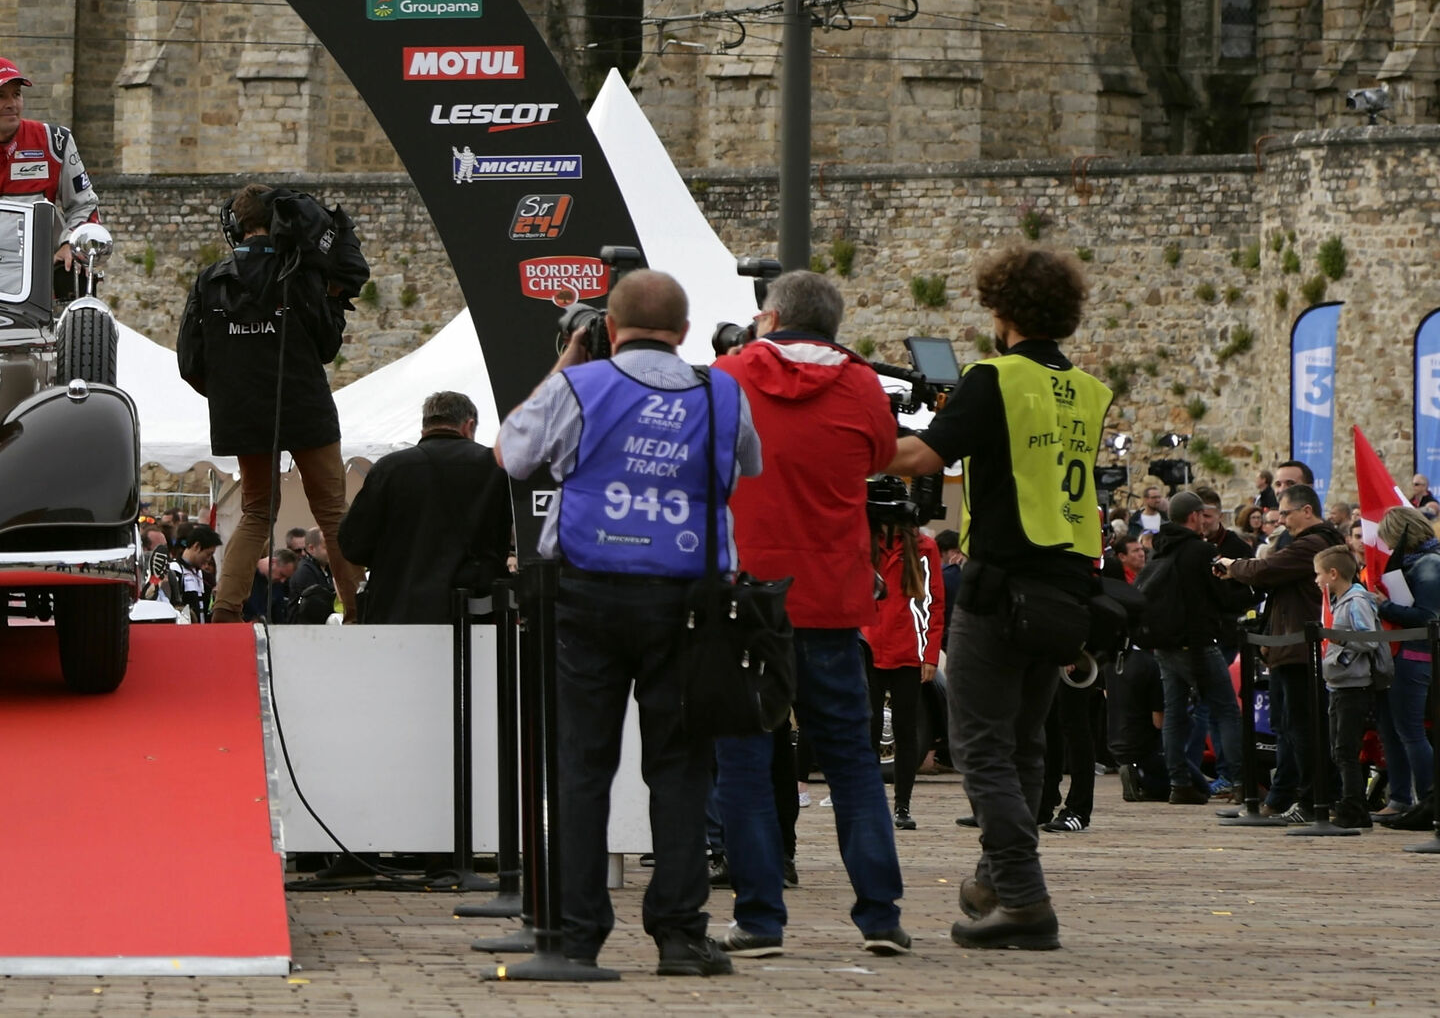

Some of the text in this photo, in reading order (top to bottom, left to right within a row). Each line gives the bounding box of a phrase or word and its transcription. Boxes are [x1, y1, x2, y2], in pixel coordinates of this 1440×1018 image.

[400, 0, 479, 15] Groupama
[408, 51, 519, 76] MOTUL
[430, 103, 559, 125] LESCOT
[479, 160, 578, 173] MICHELIN
[520, 196, 554, 217] So
[526, 264, 604, 278] BORDEAU
[528, 277, 602, 291] CHESNEL
[229, 321, 275, 335] MEDIA
[1304, 365, 1334, 406] 3
[641, 394, 687, 422] 24h
[652, 419, 682, 430] MANS
[623, 436, 689, 461] MEDIA
[624, 457, 681, 478] TRACK
[605, 481, 690, 525] 943
